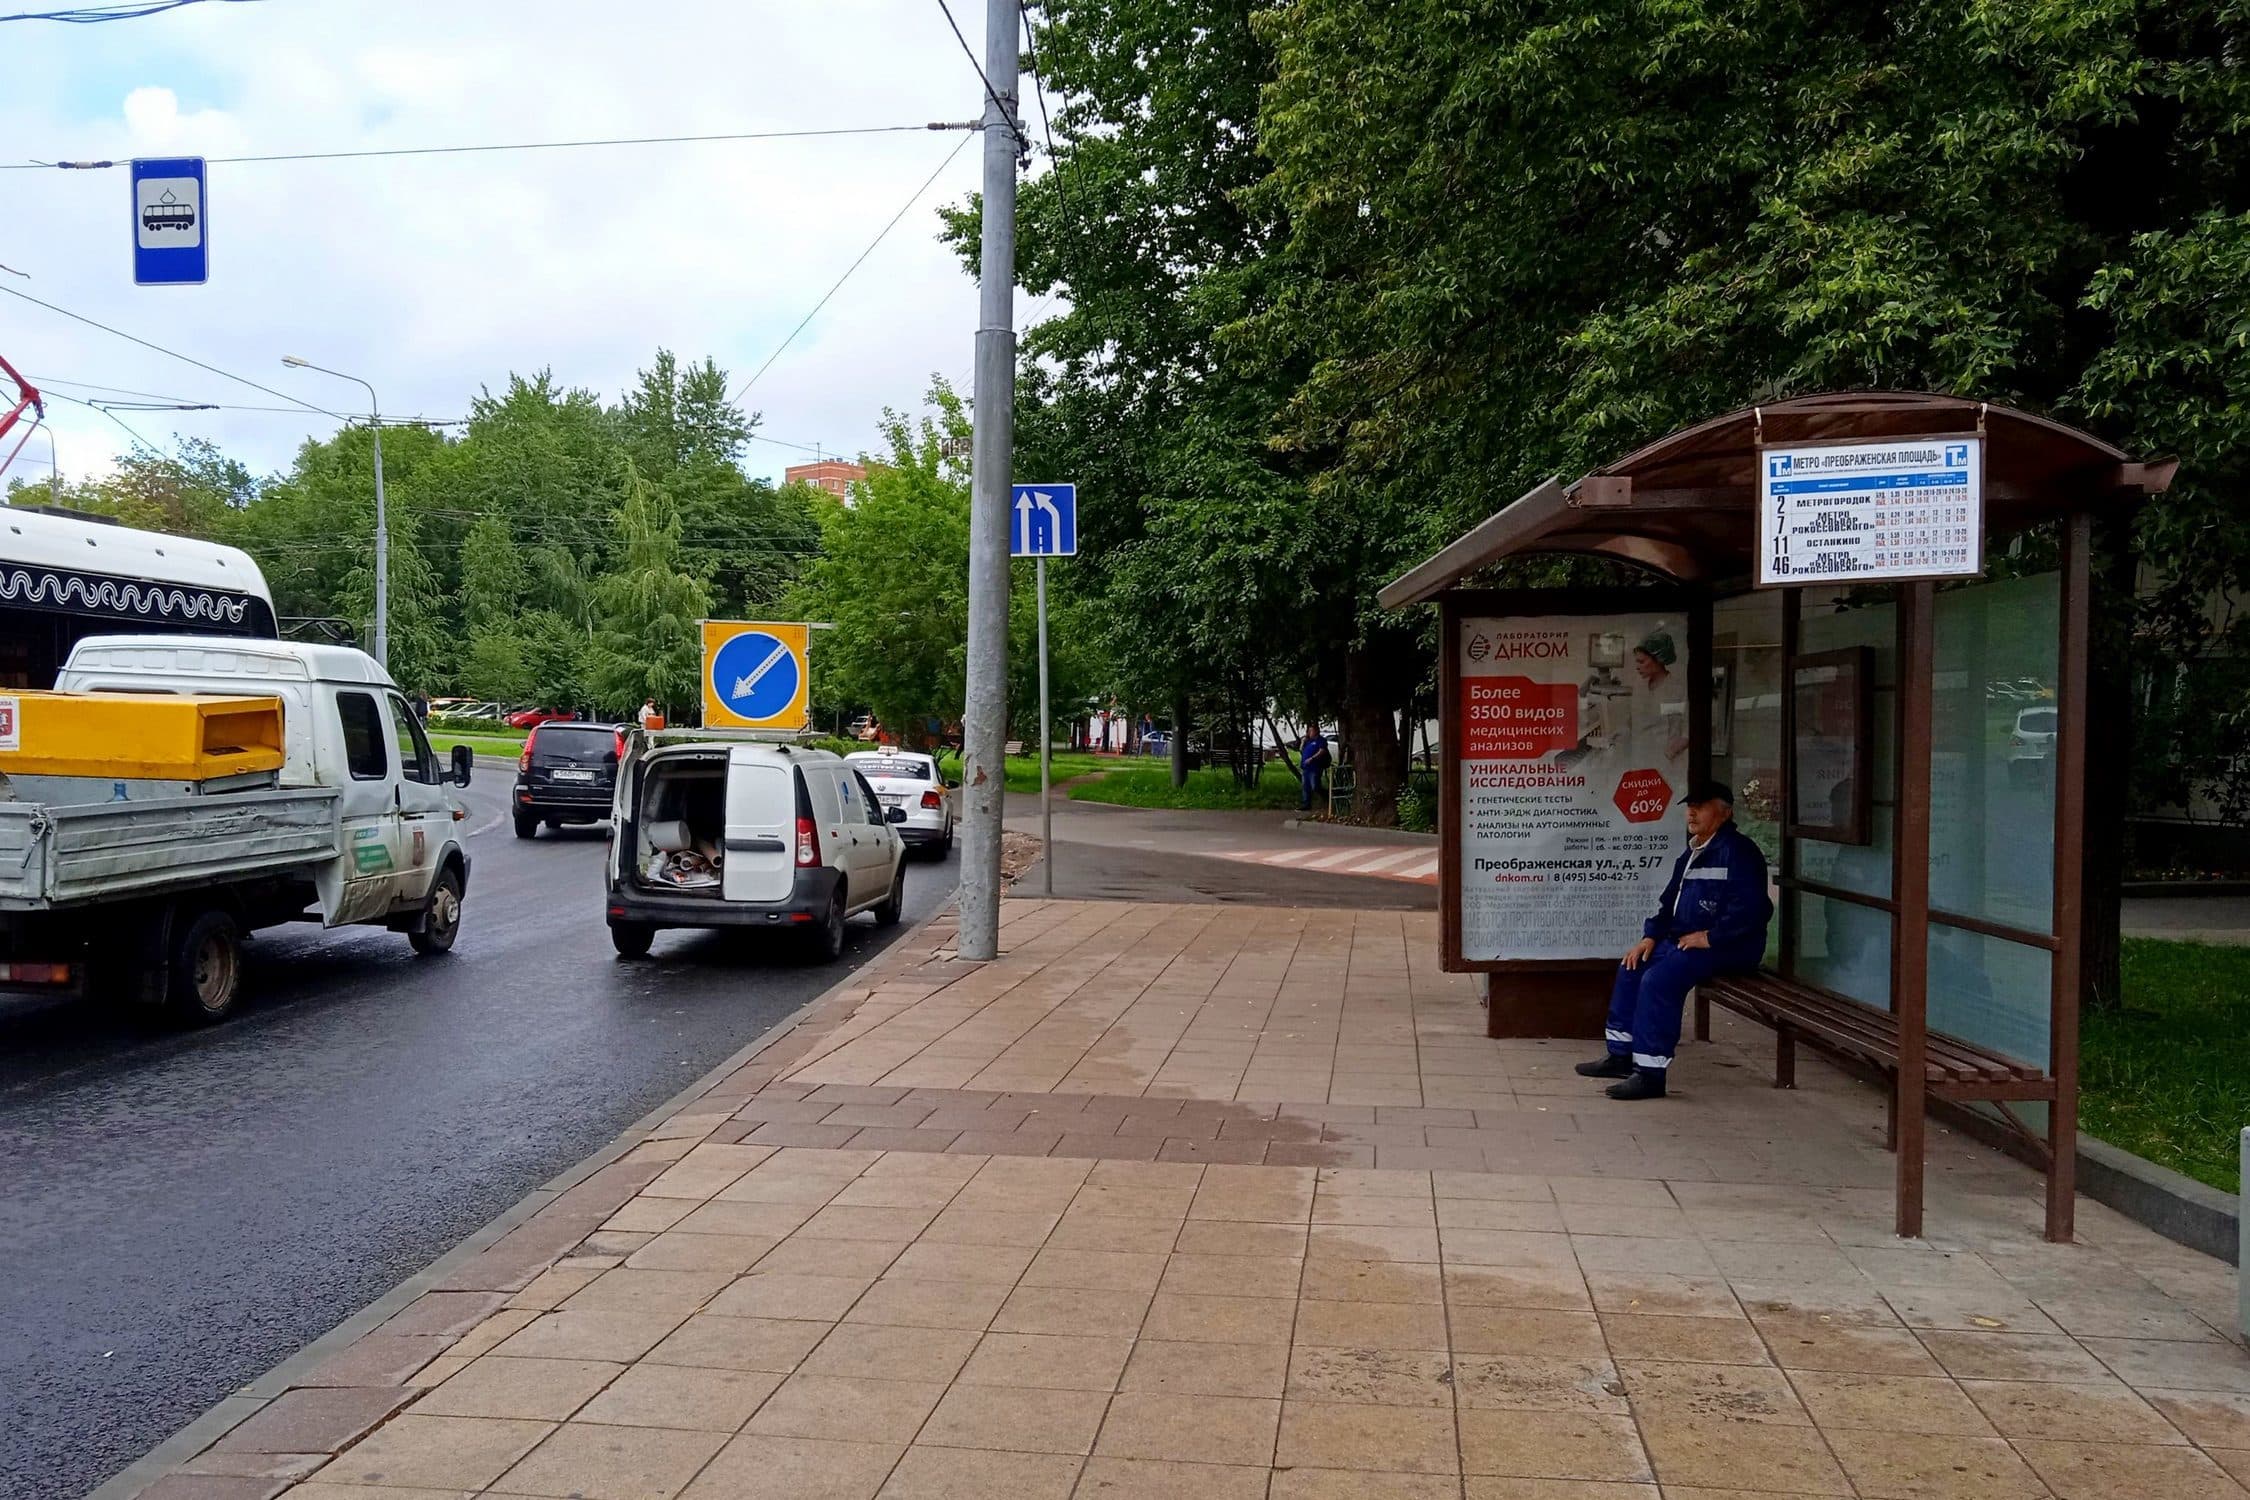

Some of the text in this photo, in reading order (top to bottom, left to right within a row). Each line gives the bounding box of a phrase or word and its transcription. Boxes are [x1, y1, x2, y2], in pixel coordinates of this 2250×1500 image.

[1793, 457, 1819, 470] МЕТРО
[1777, 496, 1785, 514] 2
[1796, 496, 1871, 508] МЕТРОГОРОДОК
[1817, 511, 1850, 520] МЕТРО
[1777, 516, 1785, 534] 7
[1773, 535, 1788, 554] 11
[1806, 537, 1861, 548] ОСТАНКИНО
[1817, 552, 1850, 561] МЕТРО
[1772, 556, 1789, 575] 46
[1495, 642, 1569, 660] ДНКОМ
[1470, 686, 1521, 699] Более
[1470, 705, 1565, 720] 3500 видов
[1470, 725, 1564, 738] медицинских
[1470, 741, 1533, 751] анализов
[1470, 764, 1568, 775] УНИКАЛЬНЫЕ
[1470, 777, 1585, 789] ИССЛЕДОВАНИЯ
[1622, 777, 1662, 789] СКИДКИ
[1477, 795, 1573, 804] ГЕНЕТИЧЕСКИЕ ТЕСТЫ
[1477, 808, 1598, 817] АНТИ-ЭЙДЖ ДИАГНОСТИКА
[1629, 799, 1663, 814] 60%
[1477, 822, 1520, 830] АНАЛИЗЫ
[1536, 820, 1611, 829] АУТОИММУННЫЕ
[1477, 831, 1531, 839] ПАТОЛОГИИ
[1475, 858, 1592, 871] Преображенская
[1622, 859, 1635, 870] д.
[1639, 856, 1663, 868] 5/7
[1495, 872, 1639, 883] dnkom.ru 8 (495) 540-42-75
